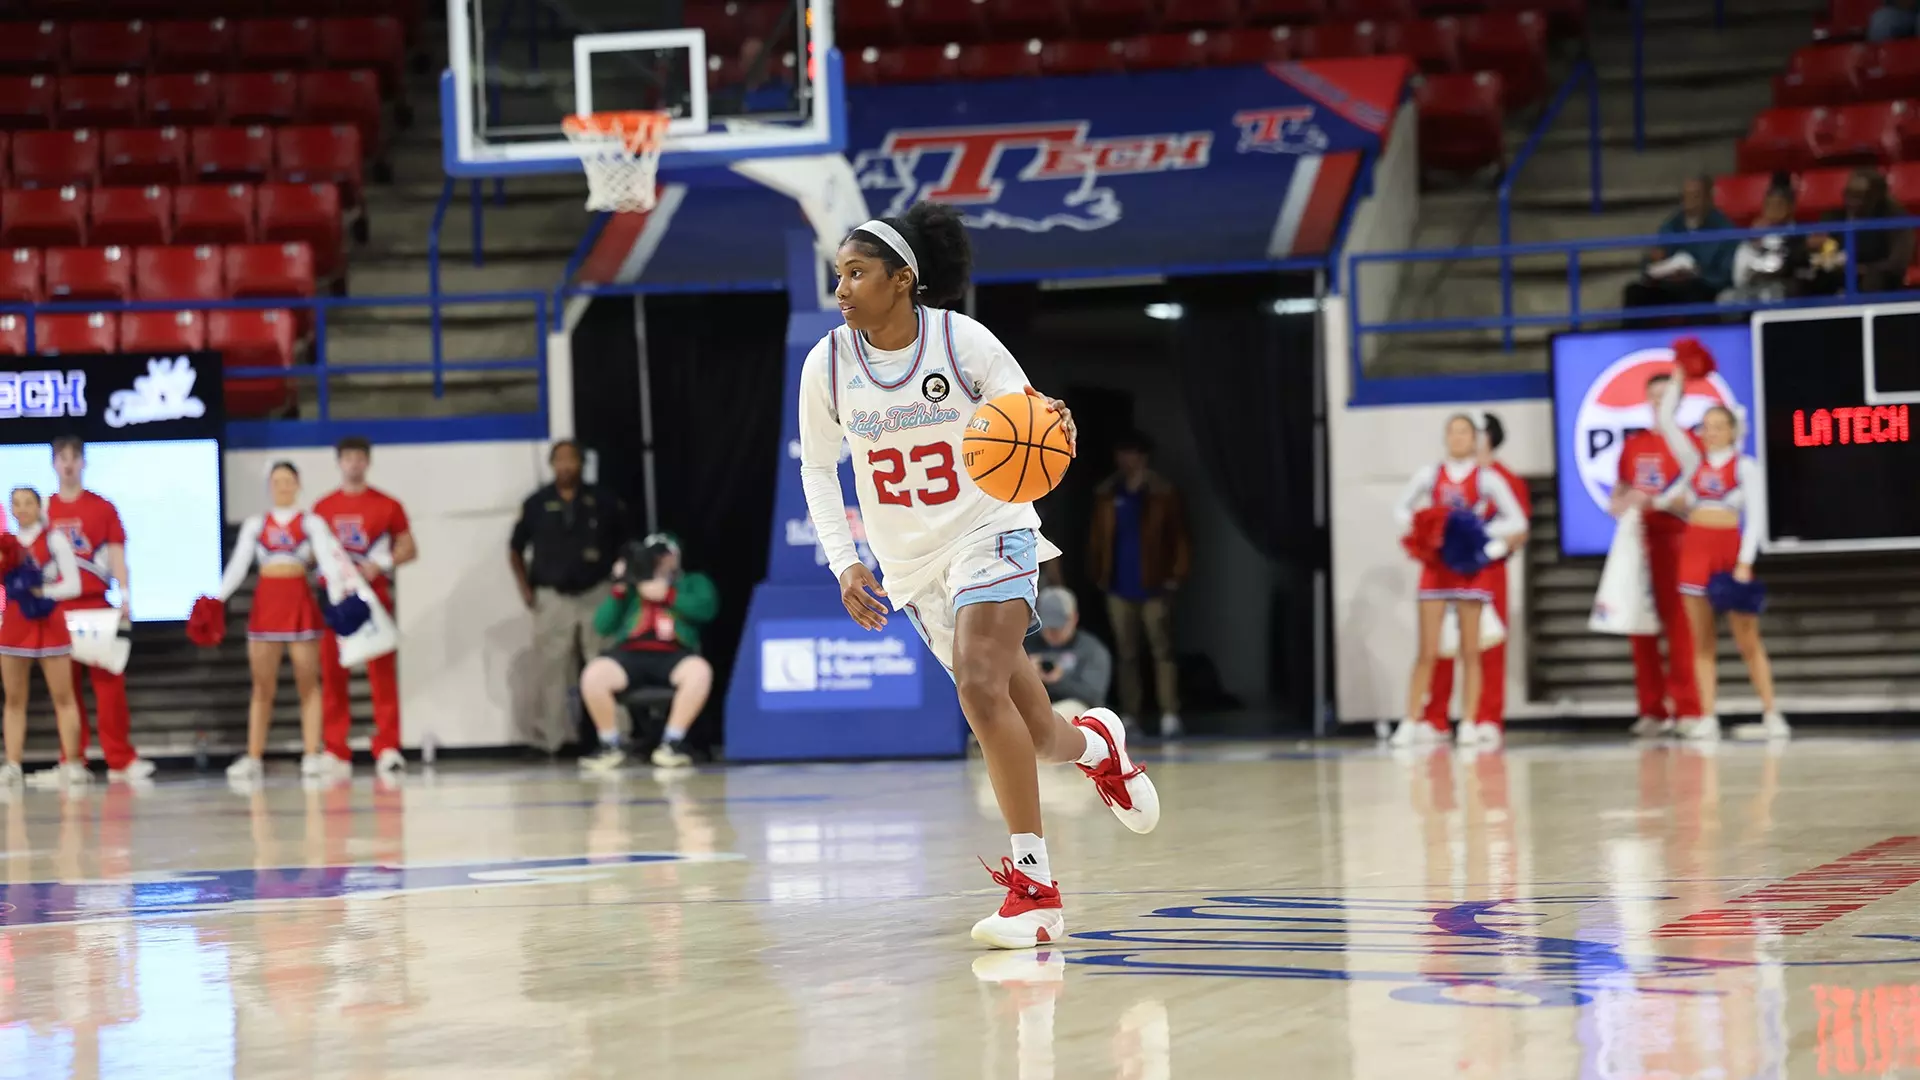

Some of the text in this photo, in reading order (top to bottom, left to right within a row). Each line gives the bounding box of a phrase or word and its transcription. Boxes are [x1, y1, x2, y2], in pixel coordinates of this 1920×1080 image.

[847, 401, 960, 443] Lady Techsters
[867, 441, 960, 507] 23
